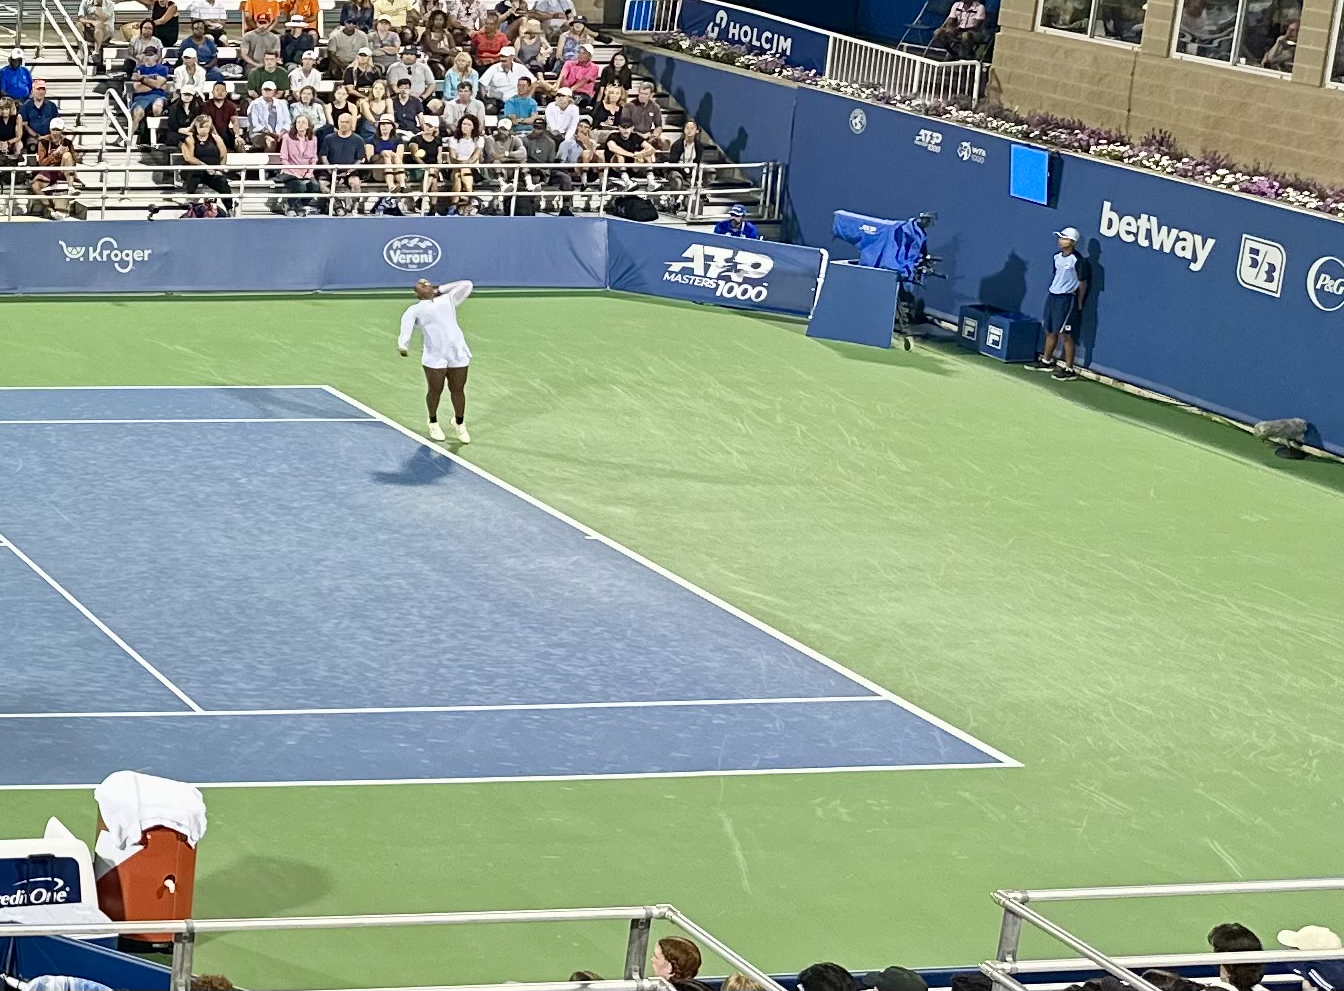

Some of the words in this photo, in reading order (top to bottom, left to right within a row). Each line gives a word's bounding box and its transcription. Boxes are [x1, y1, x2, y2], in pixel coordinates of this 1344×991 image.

[728, 21, 792, 56] HOLCIM
[1099, 200, 1216, 272] betway
[88, 236, 152, 274] Kroger
[389, 249, 433, 264] Veroni
[664, 243, 774, 283] ATP
[663, 271, 717, 289] MASTERS
[716, 279, 769, 303] 1000
